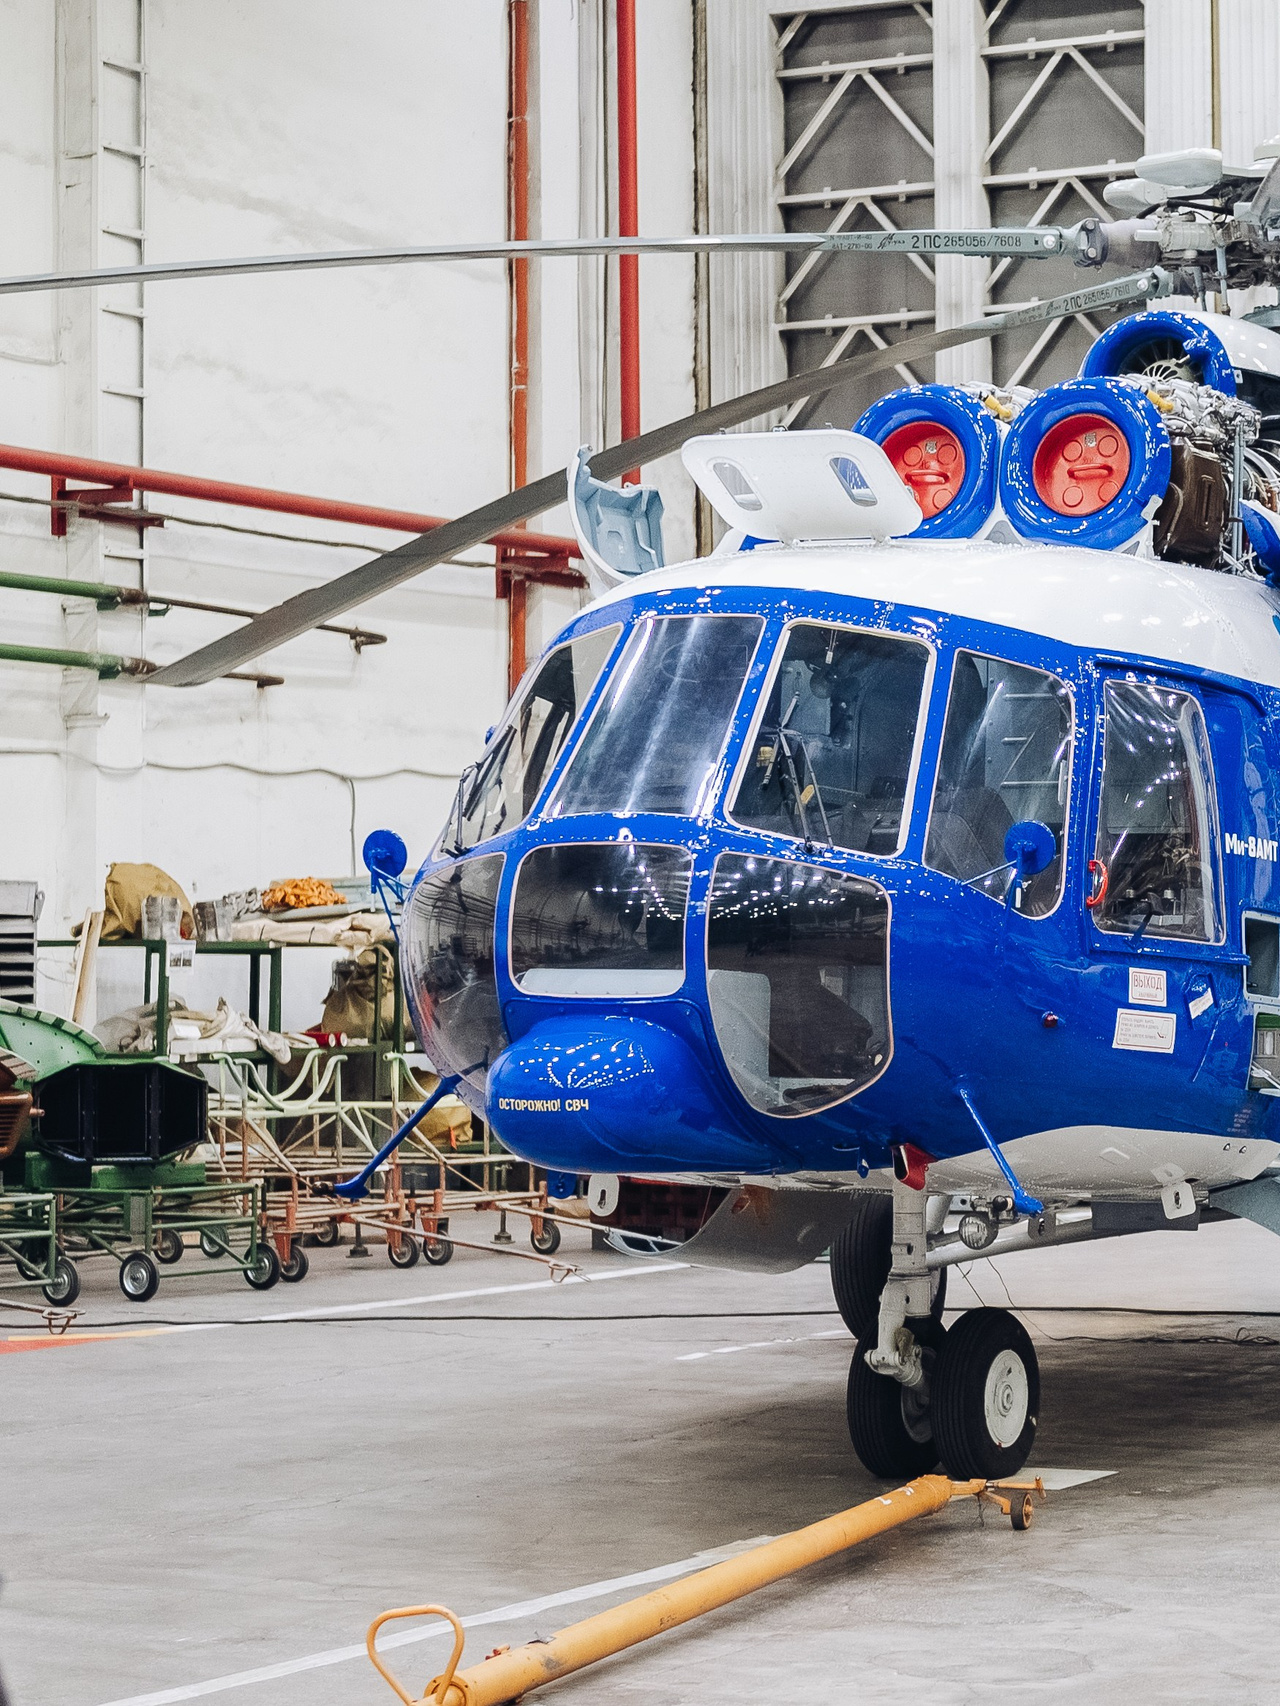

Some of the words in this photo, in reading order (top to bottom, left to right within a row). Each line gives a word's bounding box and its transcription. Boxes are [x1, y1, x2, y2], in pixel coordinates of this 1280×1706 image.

[911, 235, 920, 248] 2
[923, 235, 942, 248] ПС
[944, 235, 1021, 247] 265056/7608
[1063, 299, 1070, 312] 2
[1070, 296, 1082, 310] ПС
[1225, 833, 1278, 862] Ми-8АМТ
[1133, 974, 1162, 991] ВЫХОД
[499, 1098, 561, 1111] ОСТОРОЖНО!
[565, 1099, 589, 1111] СВЧ
